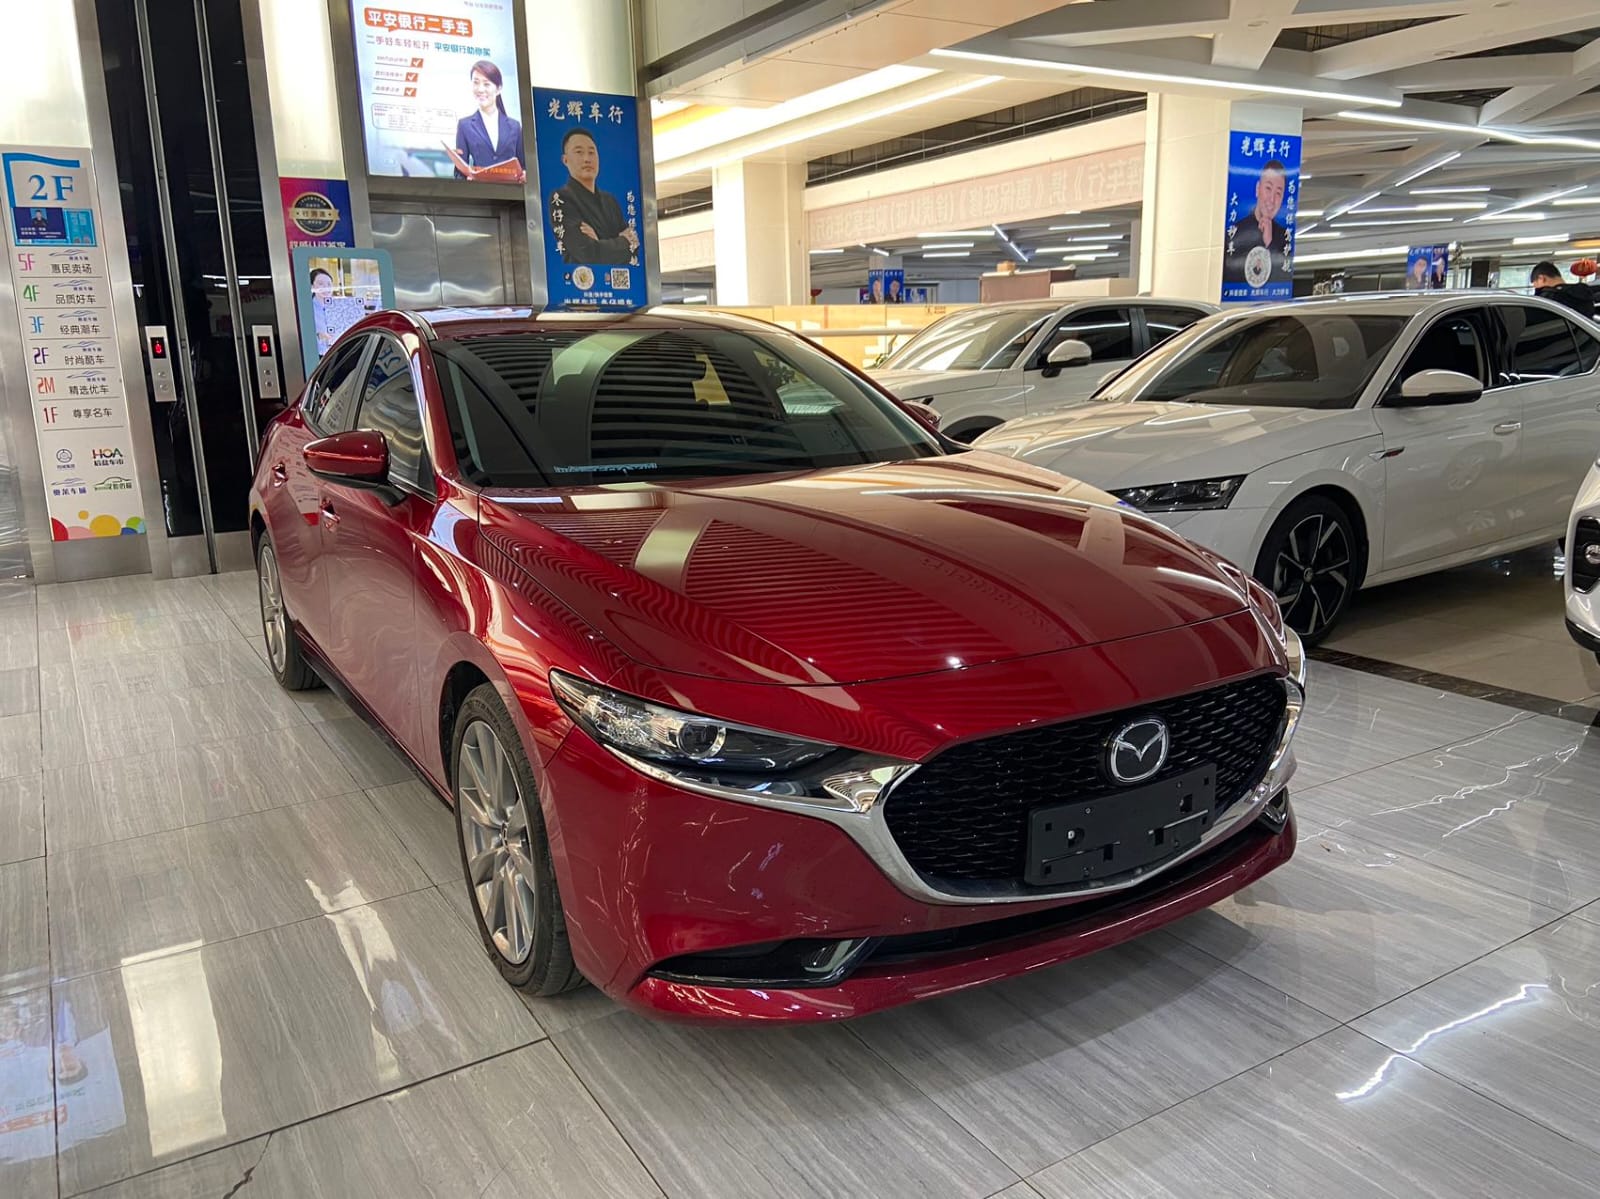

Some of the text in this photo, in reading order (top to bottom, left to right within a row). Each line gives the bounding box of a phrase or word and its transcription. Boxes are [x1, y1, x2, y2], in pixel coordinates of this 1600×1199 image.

[368, 10, 470, 35] 平安银行二手车
[366, 35, 430, 50] 二手好车轻松开
[28, 174, 74, 201] 2F
[18, 253, 36, 271] 5F
[51, 263, 92, 274] 惠民卖场
[23, 284, 40, 302] 4F
[56, 294, 96, 304] 品质好车
[28, 315, 45, 334] 3F
[60, 325, 100, 335] 经典潮车
[32, 347, 50, 365] 2F
[64, 355, 105, 366] 时尚酷车
[37, 377, 56, 395] 2M
[69, 384, 109, 395] 精选优车
[43, 407, 59, 424] 1F
[73, 408, 113, 419] 尊享名车
